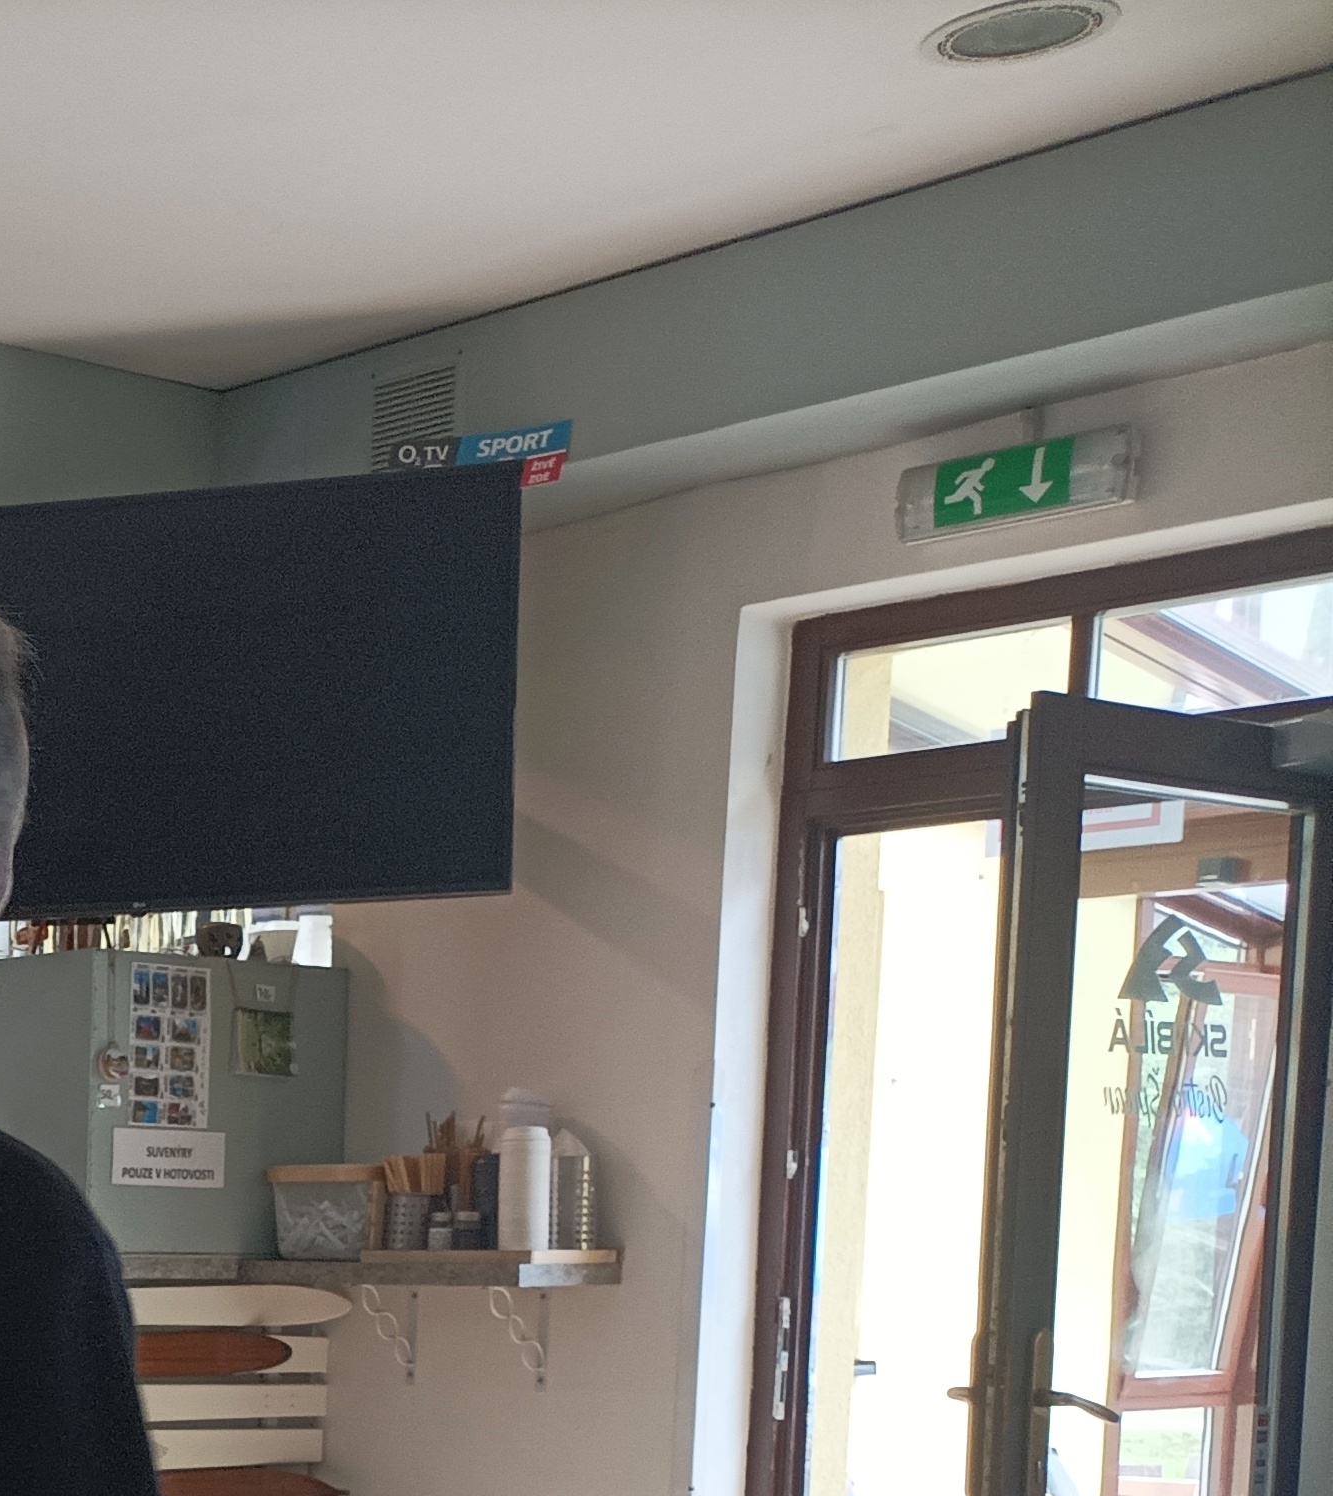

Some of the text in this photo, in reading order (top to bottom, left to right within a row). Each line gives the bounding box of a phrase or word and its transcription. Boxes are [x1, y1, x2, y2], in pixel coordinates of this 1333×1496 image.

[476, 429, 554, 458] SPORT
[145, 1143, 193, 1159] SUVENÝRY
[121, 1167, 215, 1181] POUZE V HOTOVOSTI
